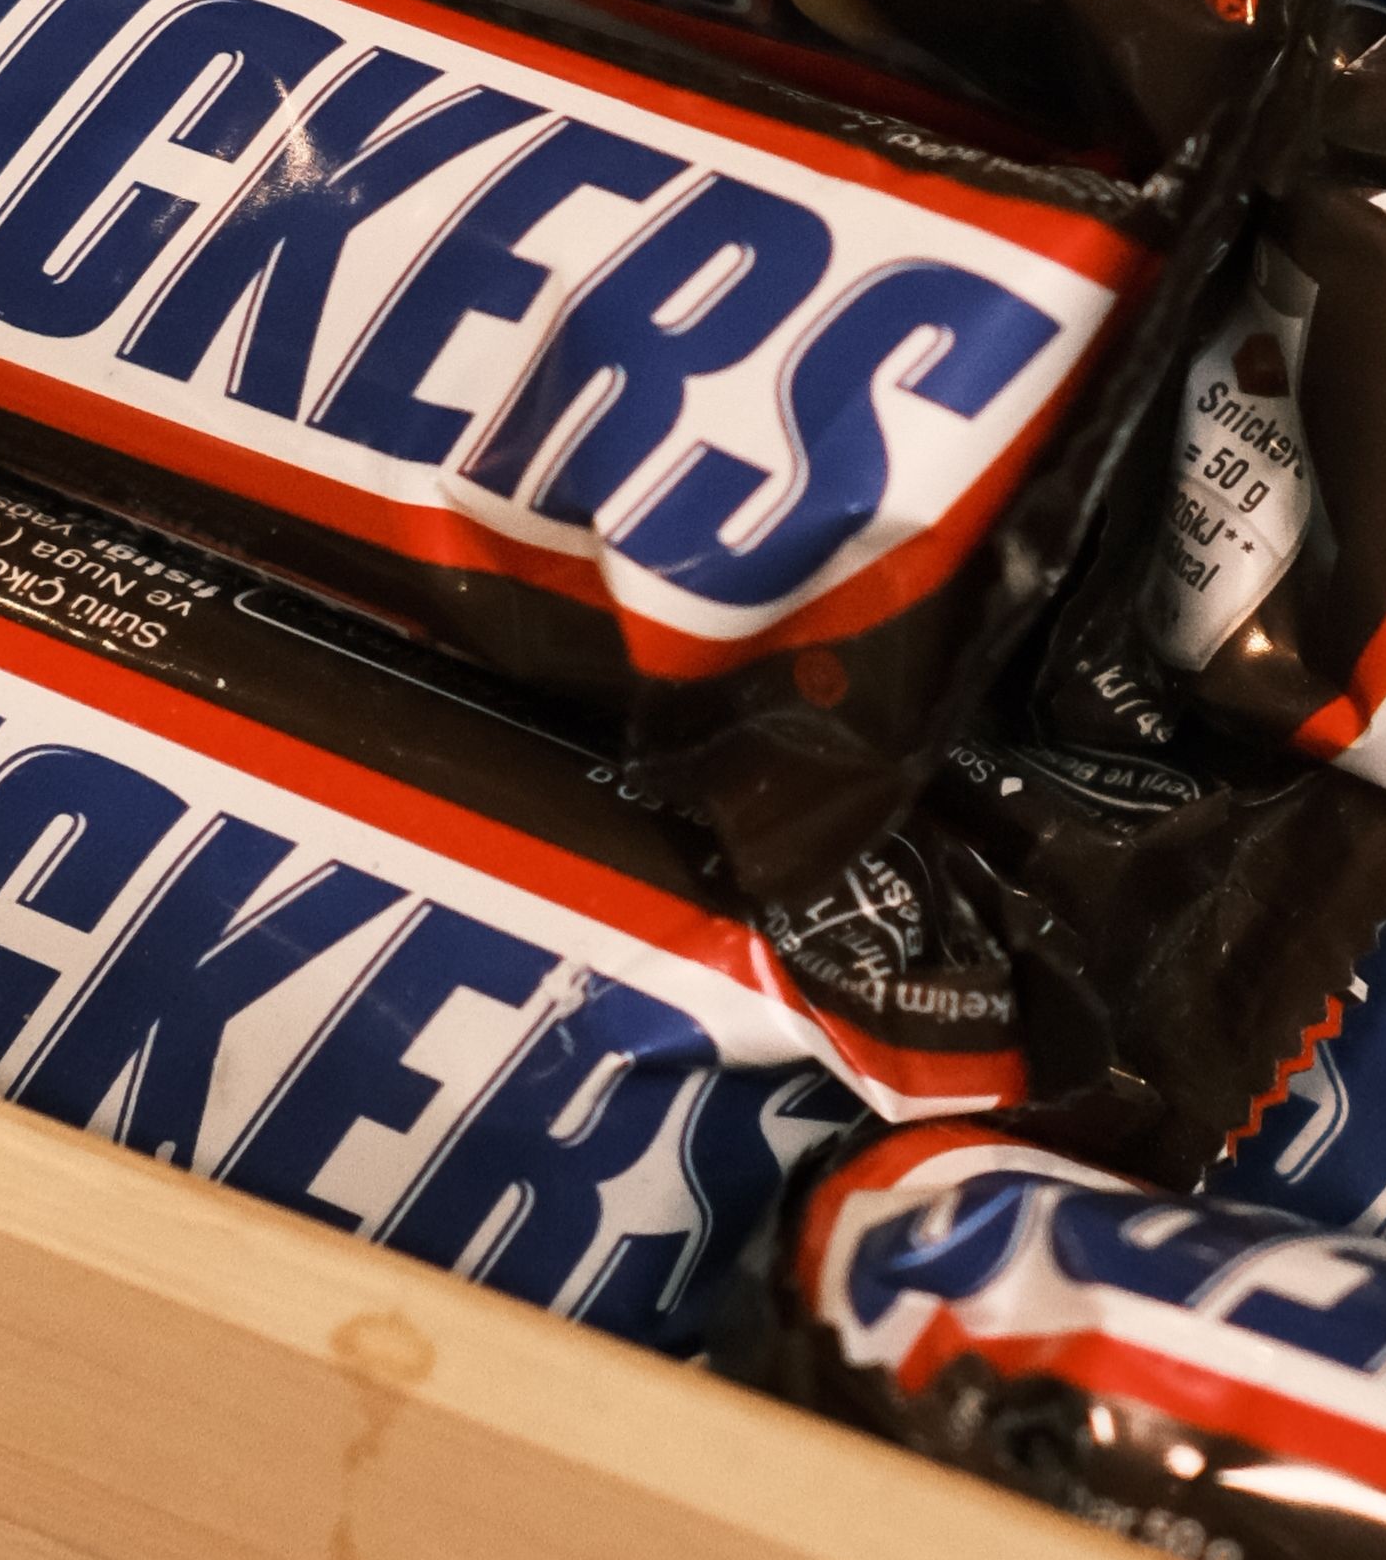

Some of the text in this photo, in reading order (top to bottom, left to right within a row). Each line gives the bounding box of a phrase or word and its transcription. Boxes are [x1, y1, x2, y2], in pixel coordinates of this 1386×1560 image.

[1201, 442, 1251, 492] 50
[1238, 478, 1270, 515] g
[31, 540, 137, 597] Nuga
[69, 594, 167, 648] Sütlü
[145, 589, 192, 617] ve
